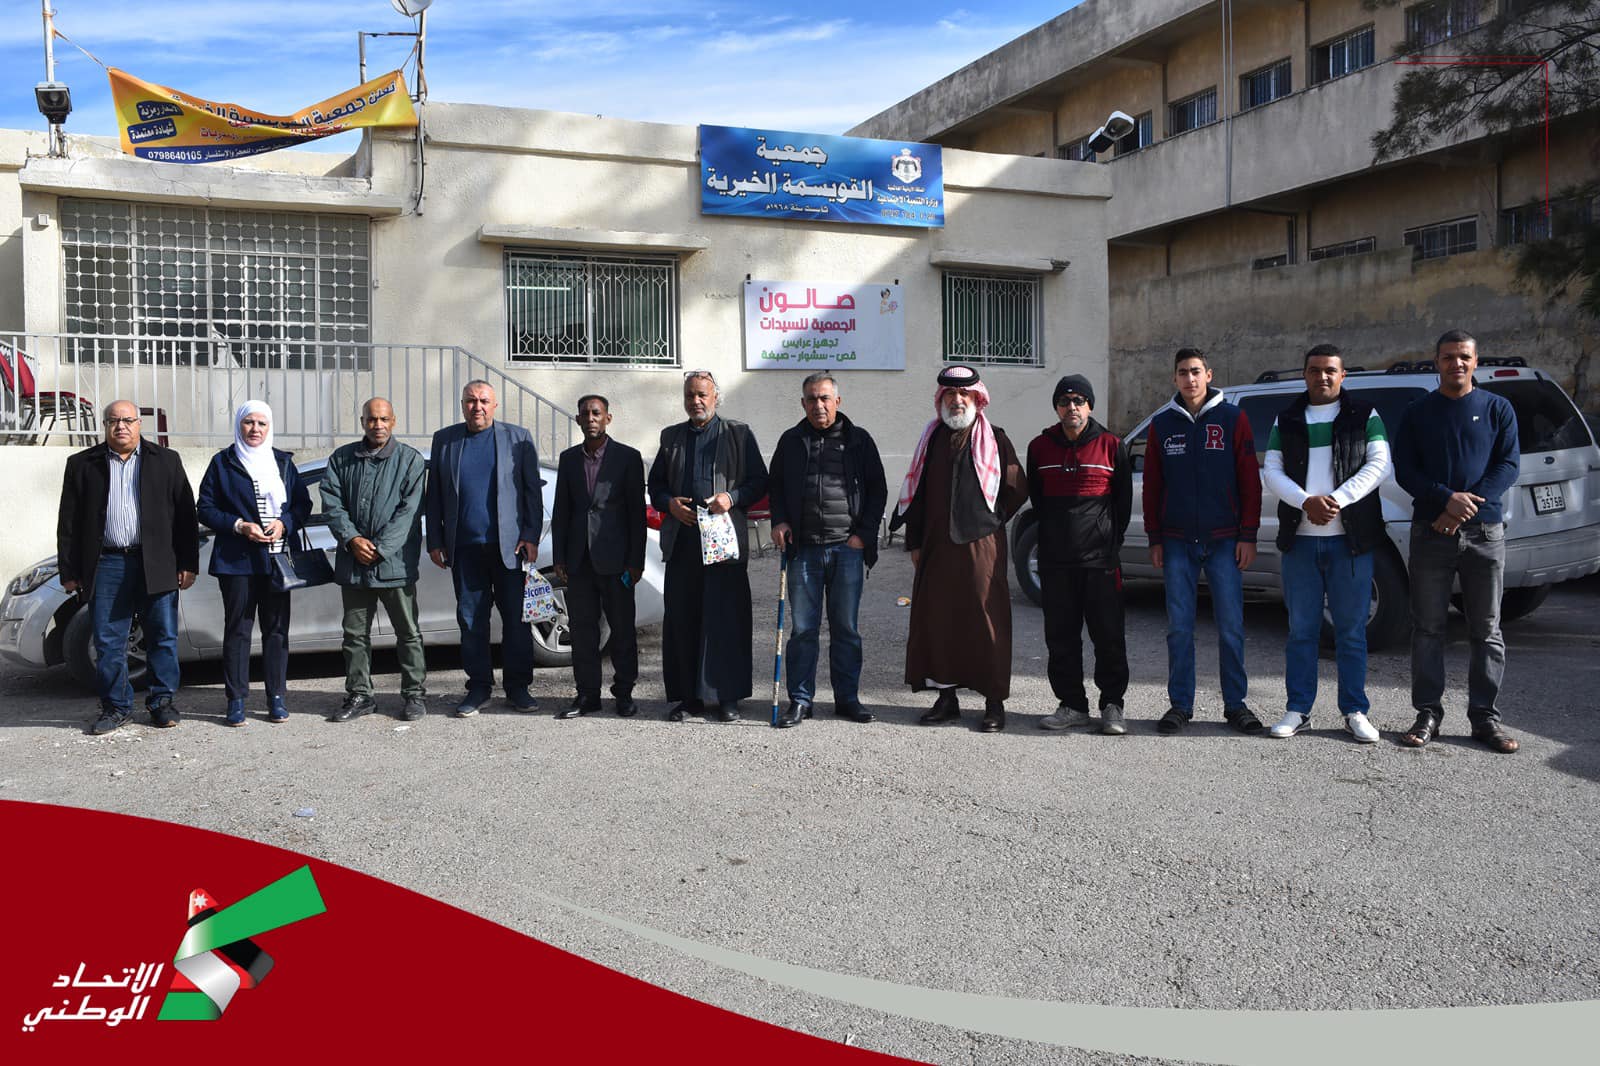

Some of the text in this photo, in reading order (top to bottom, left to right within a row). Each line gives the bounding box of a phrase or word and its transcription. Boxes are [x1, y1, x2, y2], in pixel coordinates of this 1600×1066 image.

[368, 81, 396, 105] تعلن
[312, 97, 367, 125] جمعية
[147, 150, 202, 160] 0798640105
[756, 137, 828, 168] جمعية
[706, 168, 873, 203] القويسمة الخيرية
[759, 287, 856, 313] صالون
[760, 317, 856, 334] الجمعية للسيدات
[782, 337, 839, 349] تجهيز عرايس
[761, 350, 789, 361] صبغة
[797, 349, 828, 362] سشوار
[836, 351, 856, 362] قص
[1205, 424, 1224, 450] R
